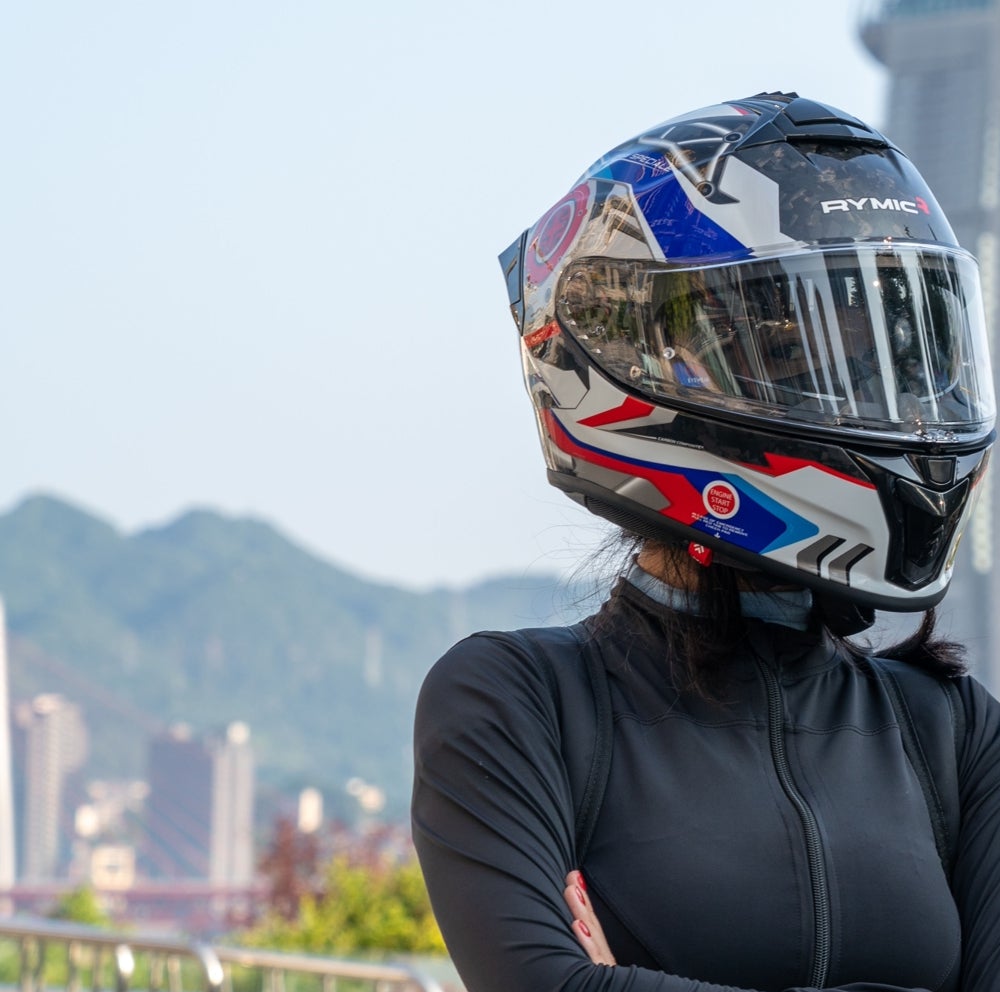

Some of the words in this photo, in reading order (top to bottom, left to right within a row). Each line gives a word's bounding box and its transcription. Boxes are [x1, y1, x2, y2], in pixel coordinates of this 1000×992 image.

[711, 489, 733, 500] ENGINE
[711, 496, 730, 506] START
[712, 504, 729, 513] STOP
